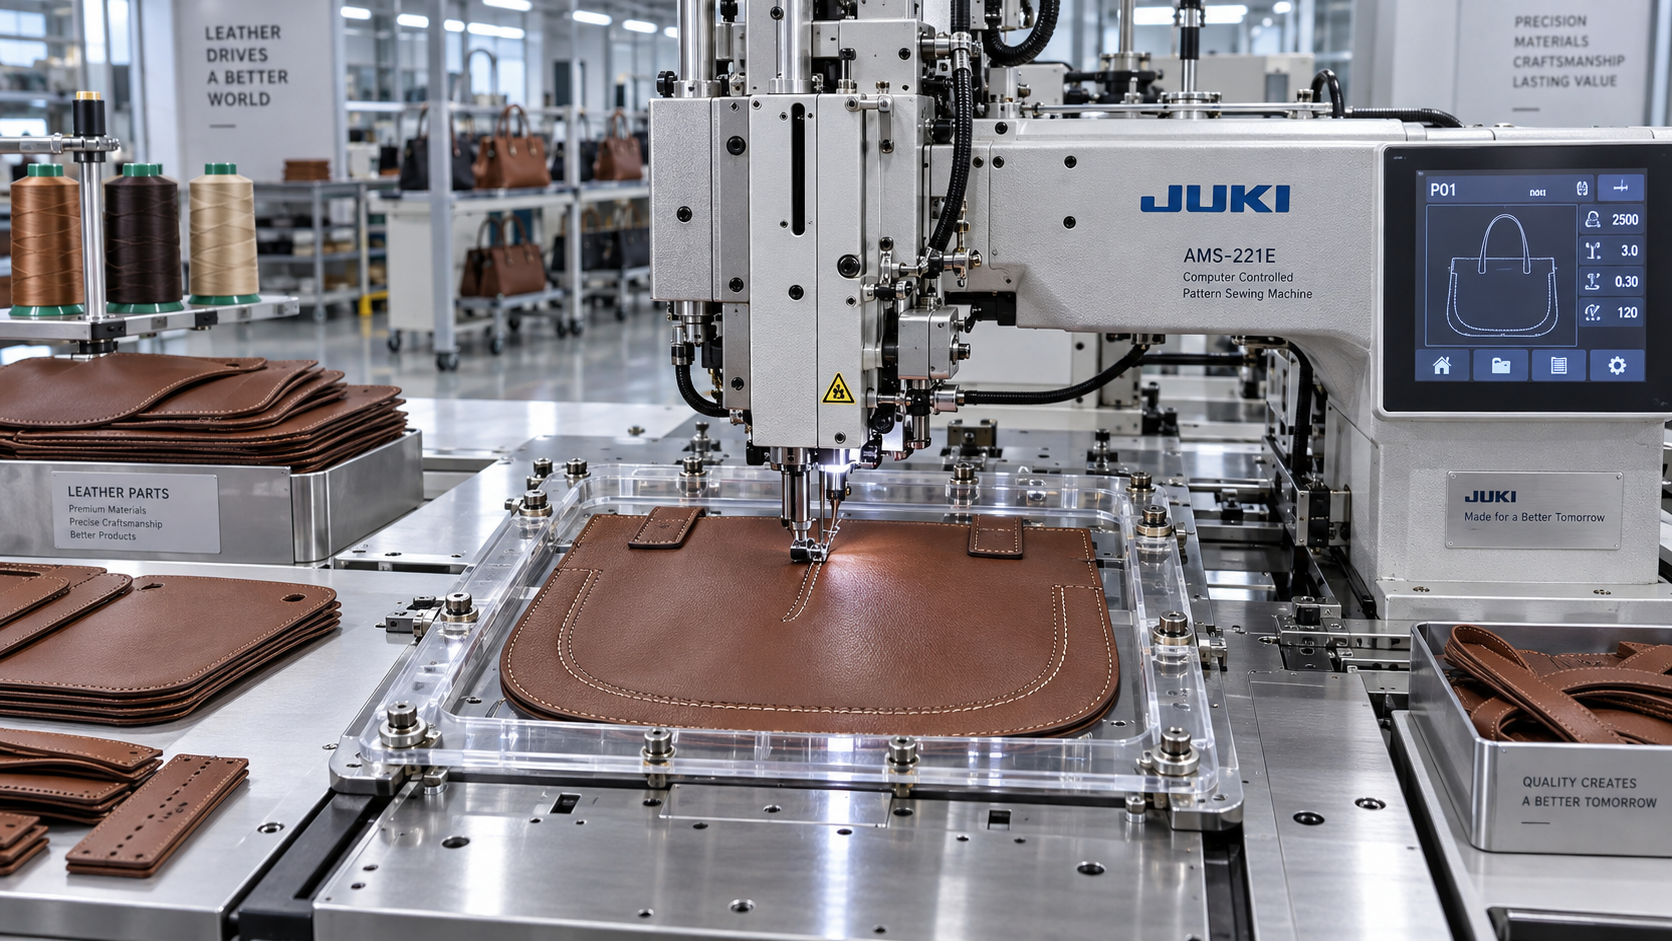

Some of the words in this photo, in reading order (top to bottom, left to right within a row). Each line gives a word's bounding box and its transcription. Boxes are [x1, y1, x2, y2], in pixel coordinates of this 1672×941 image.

[1514, 15, 1587, 28] PRECISION
[205, 25, 281, 41] LEATHER
[1514, 35, 1589, 48] MATERIALS
[207, 48, 268, 62] DRIVES
[1513, 54, 1625, 68] CRAFTSMANSHIP
[207, 70, 219, 84] A
[225, 70, 287, 84] BETTER
[1512, 75, 1569, 88] LASTING
[1575, 75, 1617, 87] VALUE
[208, 92, 270, 106] WORLD
[1430, 182, 1456, 197] P01
[1140, 185, 1290, 213] JUKI
[1612, 213, 1639, 226] 2500
[1184, 248, 1275, 263] AMS-221E
[1621, 244, 1639, 257] 3.0
[1183, 272, 1235, 284] Computer
[1239, 271, 1293, 282] Controlled
[1614, 275, 1639, 288] 0.30
[1183, 288, 1221, 298] Pattern
[1226, 288, 1264, 302] Sewing
[1268, 288, 1312, 298] Machine
[1617, 306, 1638, 319] 120
[68, 486, 124, 499] LEATHER
[129, 487, 169, 499] PARTS
[1465, 491, 1516, 502] JUKI
[69, 505, 105, 514] Premium
[108, 505, 146, 515] Materials
[69, 517, 99, 527] Precise
[102, 517, 163, 530] Craftsmanship
[1465, 512, 1491, 522] Made
[1495, 512, 1509, 522] for
[1512, 514, 1518, 522] a
[1521, 512, 1552, 522] Better
[1555, 512, 1605, 522] Tomorrow
[70, 530, 96, 540] Better
[98, 530, 136, 541] Products
[1523, 776, 1576, 789] QUALITY
[1581, 777, 1636, 789] CREATES
[1521, 795, 1531, 807] A
[1535, 796, 1580, 807] BETTER
[1585, 796, 1657, 808] TOMORROW
